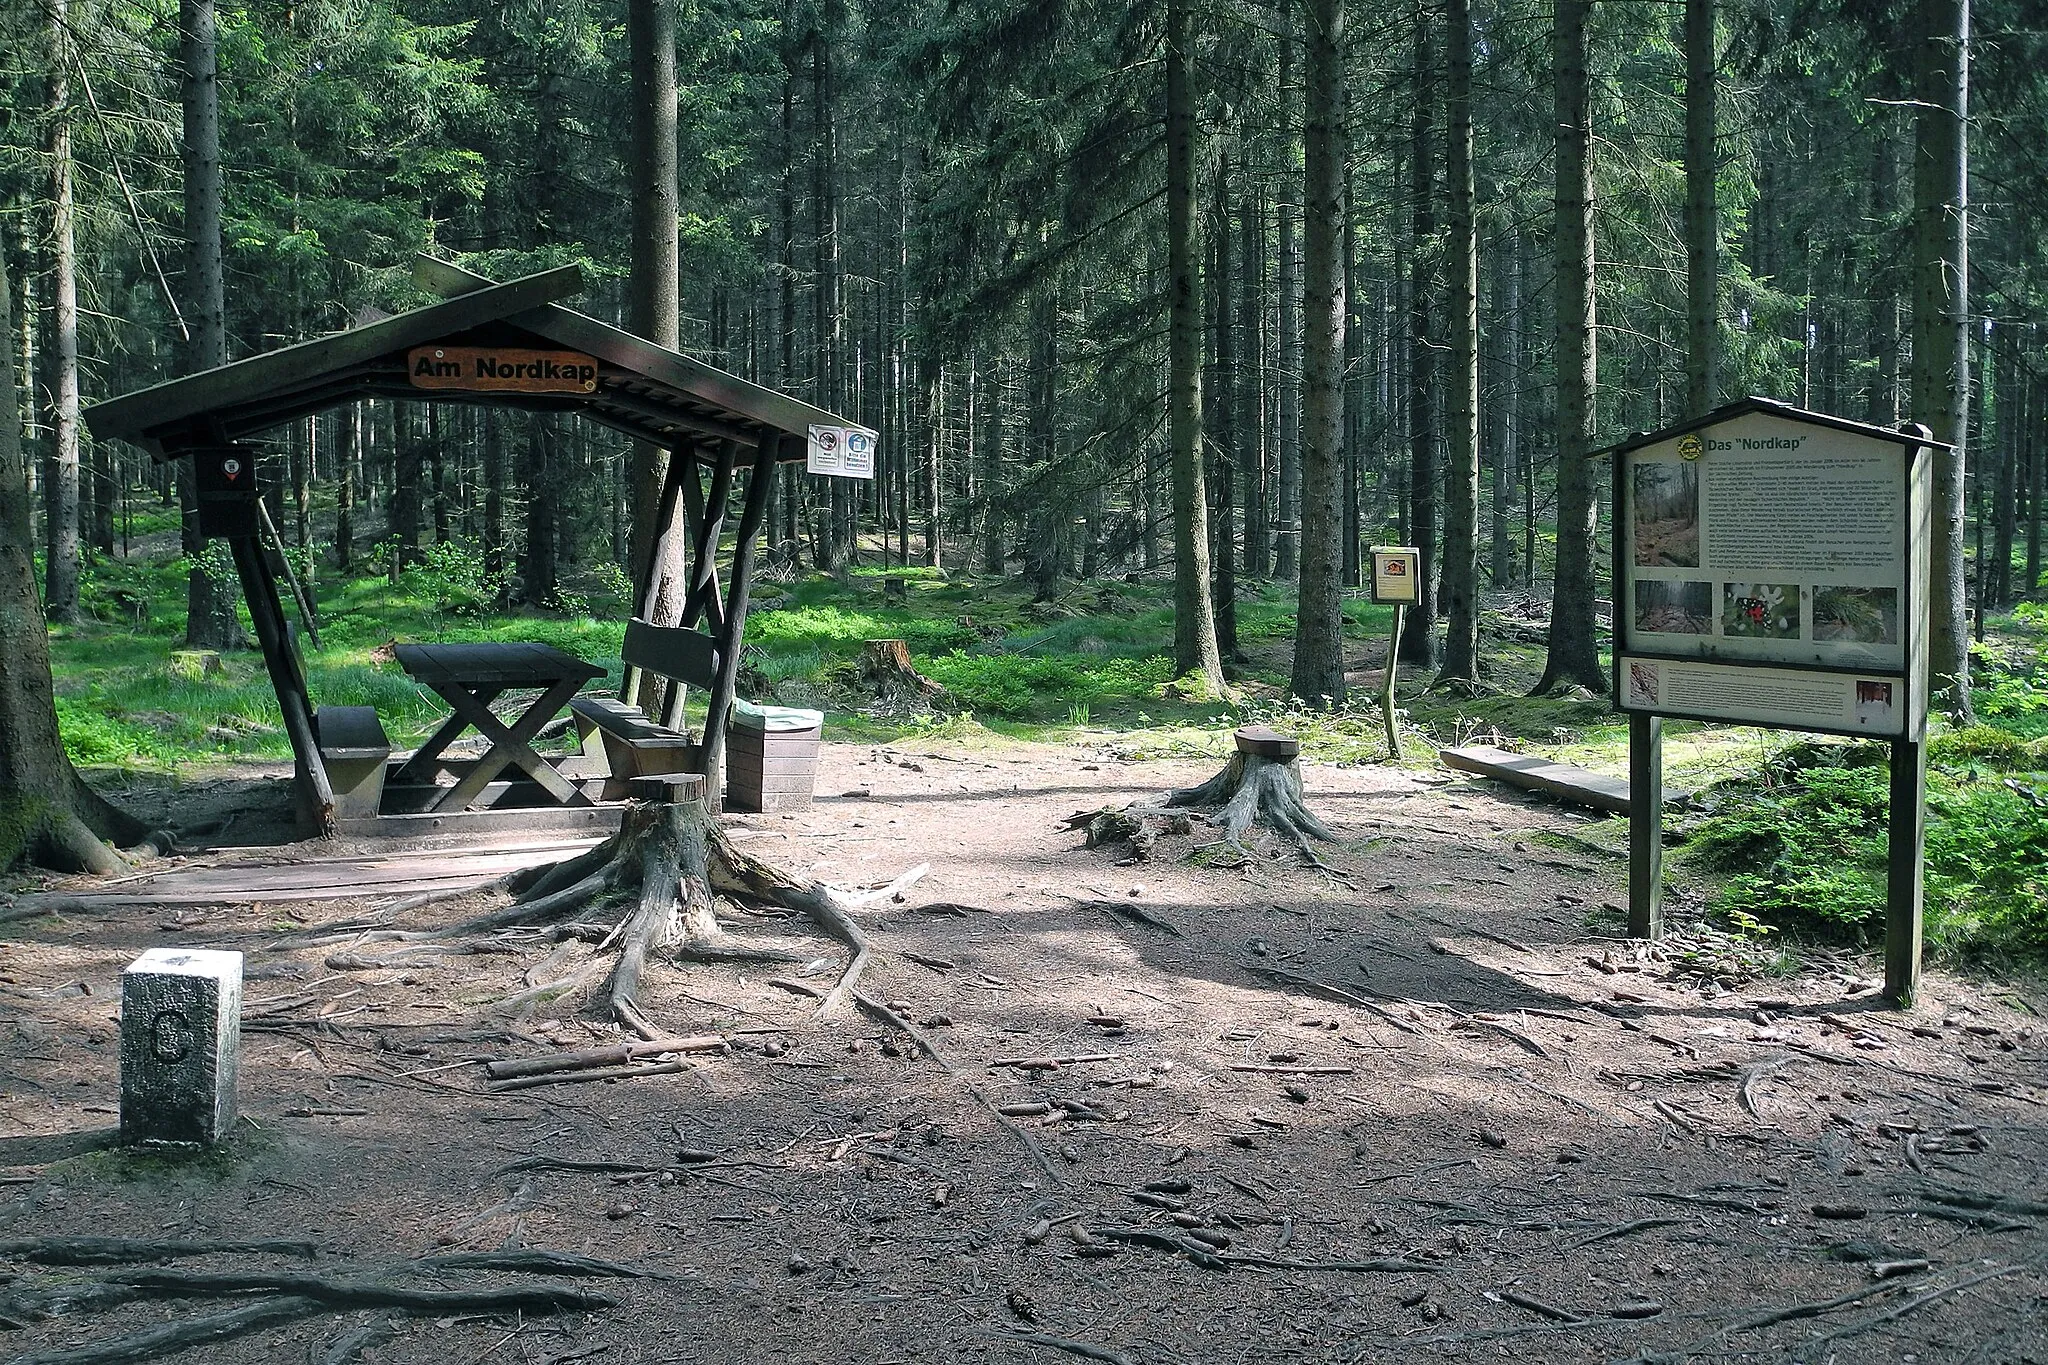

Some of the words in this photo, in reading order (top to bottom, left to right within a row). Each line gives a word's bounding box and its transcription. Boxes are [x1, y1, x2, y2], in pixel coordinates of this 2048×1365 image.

[414, 357, 461, 377] Am
[476, 358, 595, 384] Nordkap
[1708, 440, 1732, 451] Das
